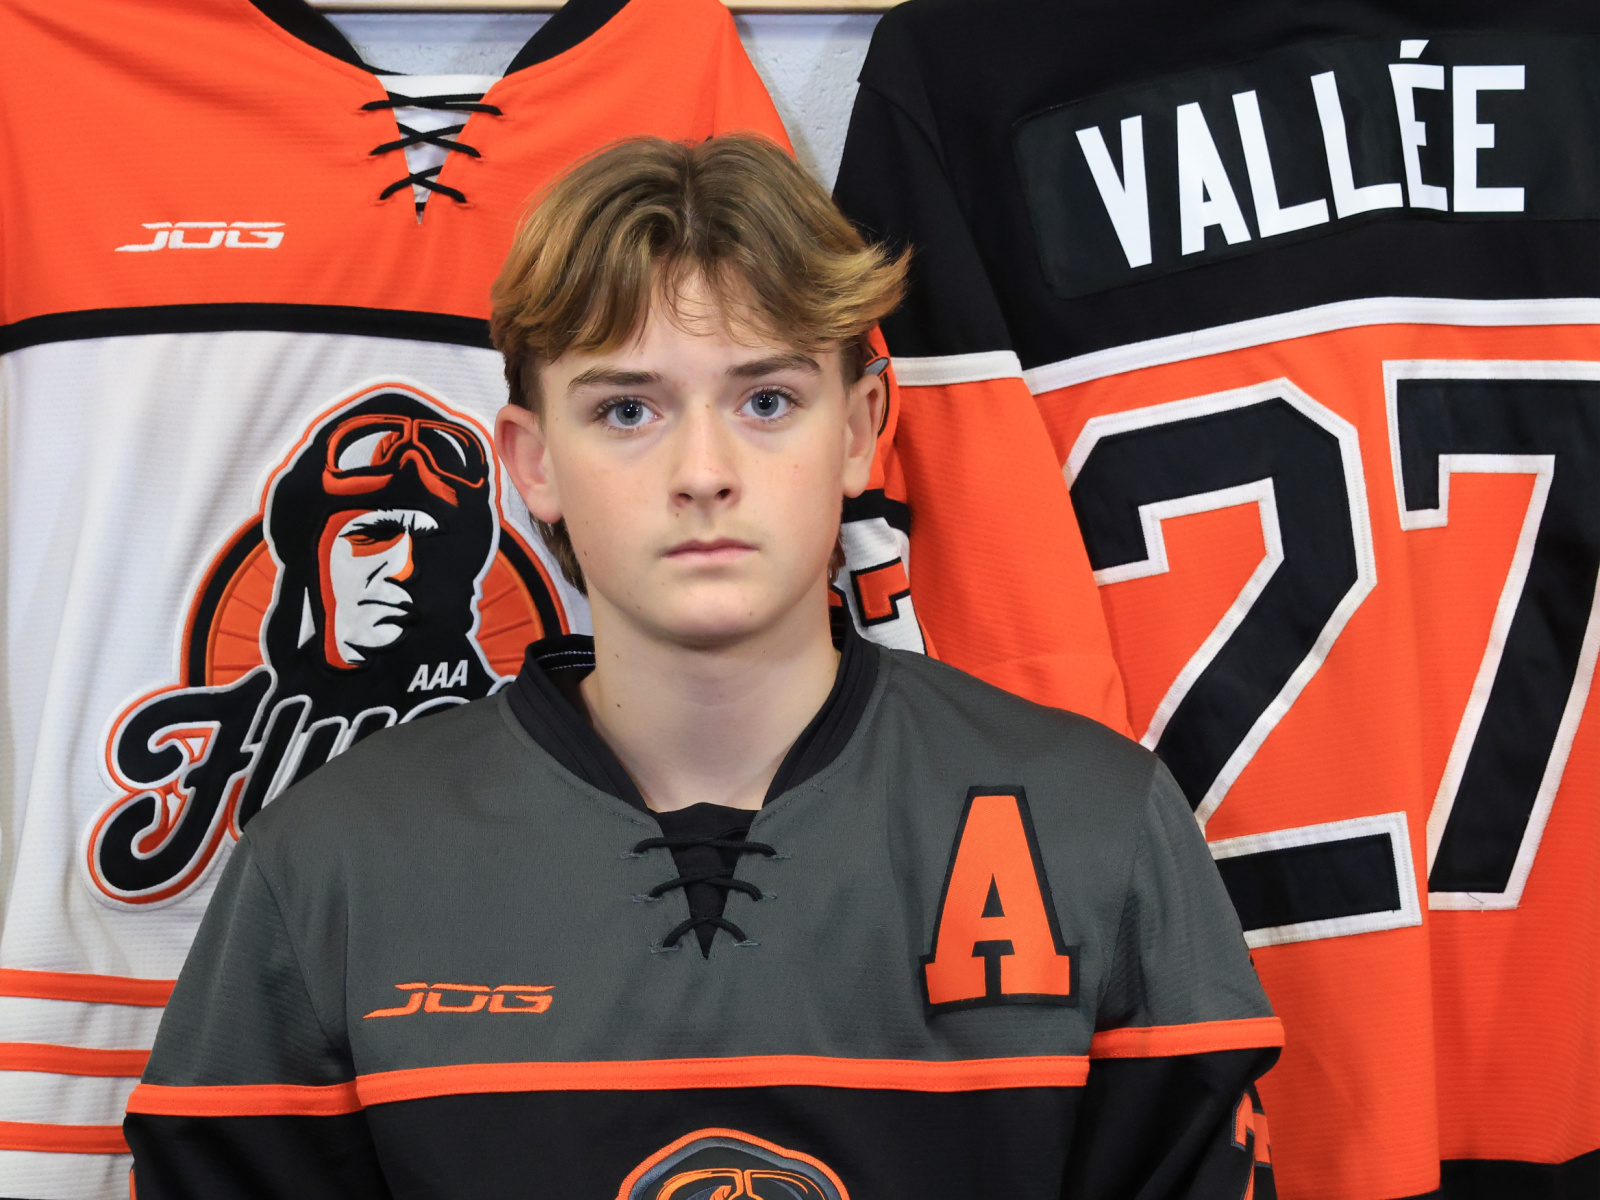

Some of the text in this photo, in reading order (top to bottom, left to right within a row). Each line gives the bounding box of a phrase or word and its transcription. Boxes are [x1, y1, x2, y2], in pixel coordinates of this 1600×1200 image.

[1076, 39, 1525, 268] VALLÉE
[114, 221, 286, 252] JOG
[407, 659, 469, 693] AAA
[1063, 360, 1600, 947] 27
[920, 786, 1080, 1015] A
[363, 982, 556, 1019] JOG
